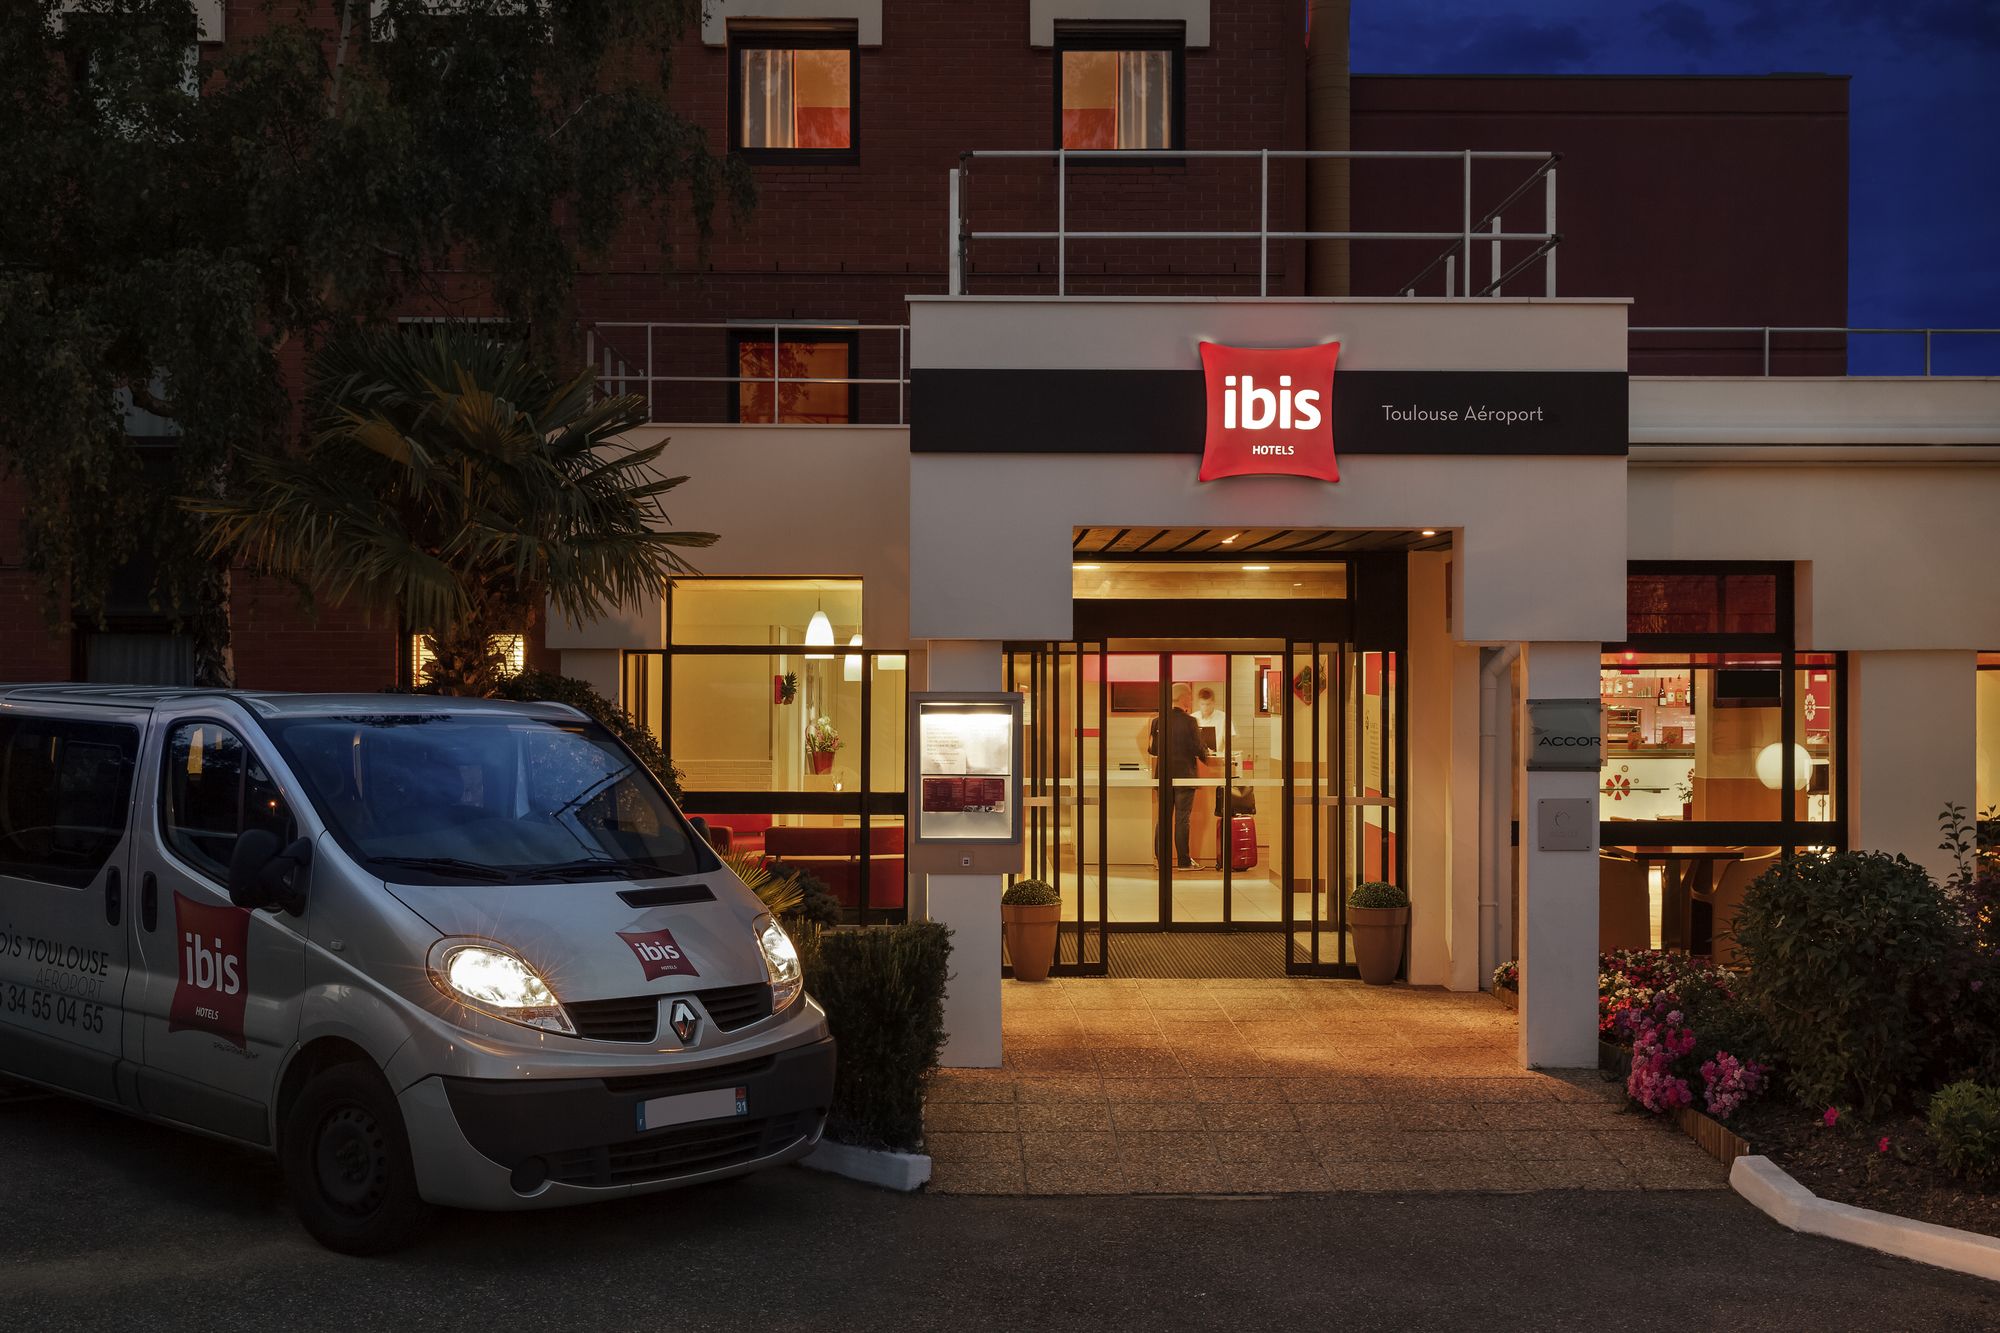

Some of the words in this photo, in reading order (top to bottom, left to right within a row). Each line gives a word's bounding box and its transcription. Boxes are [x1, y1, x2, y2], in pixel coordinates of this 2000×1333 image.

[1224, 375, 1322, 430] ibis
[1381, 404, 1459, 422] Toulouse
[1464, 405, 1544, 426] Aéroport
[1252, 445, 1295, 455] HOTELS
[1538, 736, 1602, 747] ACCOR
[27, 936, 109, 976] TOULOUSE
[634, 941, 680, 961] ibis
[185, 932, 240, 995] ibis
[8, 985, 26, 1014] 34
[32, 990, 51, 1020] 55
[57, 997, 76, 1026] 04
[83, 1003, 103, 1033] 55
[195, 1006, 219, 1020] HOTELS
[736, 1101, 747, 1112] 31
